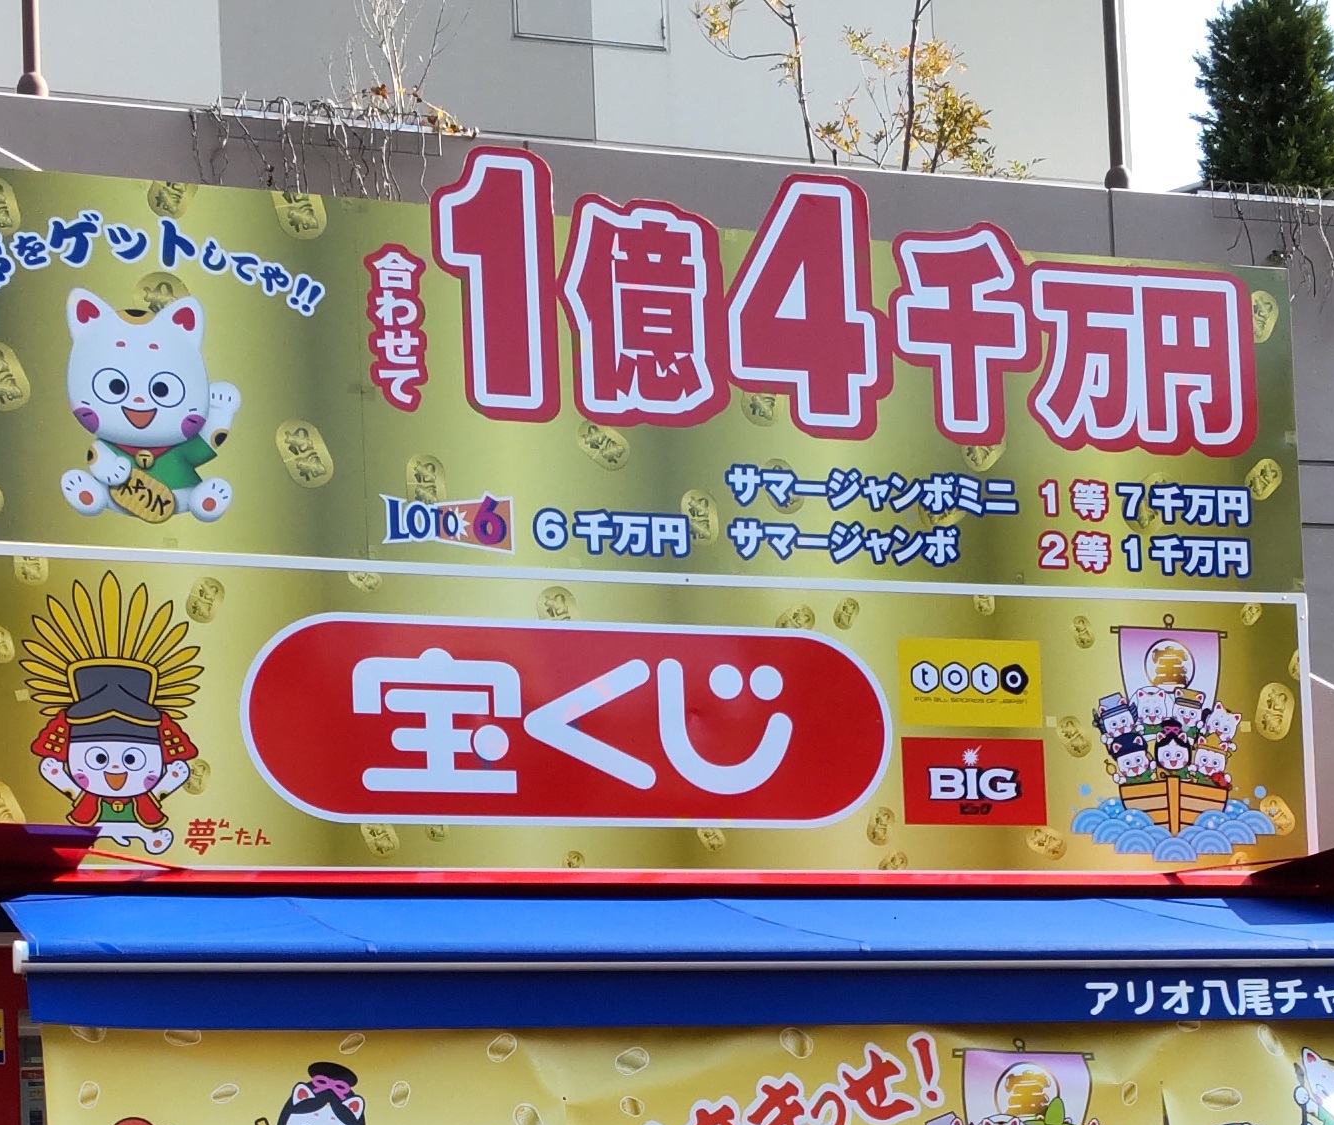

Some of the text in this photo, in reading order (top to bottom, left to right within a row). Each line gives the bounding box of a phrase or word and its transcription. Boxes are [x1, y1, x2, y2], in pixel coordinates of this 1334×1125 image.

[435, 151, 1249, 453] 1億4千万円
[372, 251, 420, 404] 合わせて
[727, 466, 1018, 515] サマージャンボミニ
[533, 509, 689, 558] 6千万円
[730, 518, 961, 567] サマージャンボ
[917, 665, 1025, 691] toto
[353, 647, 795, 796] 宝くじ
[928, 767, 1019, 801] BIG
